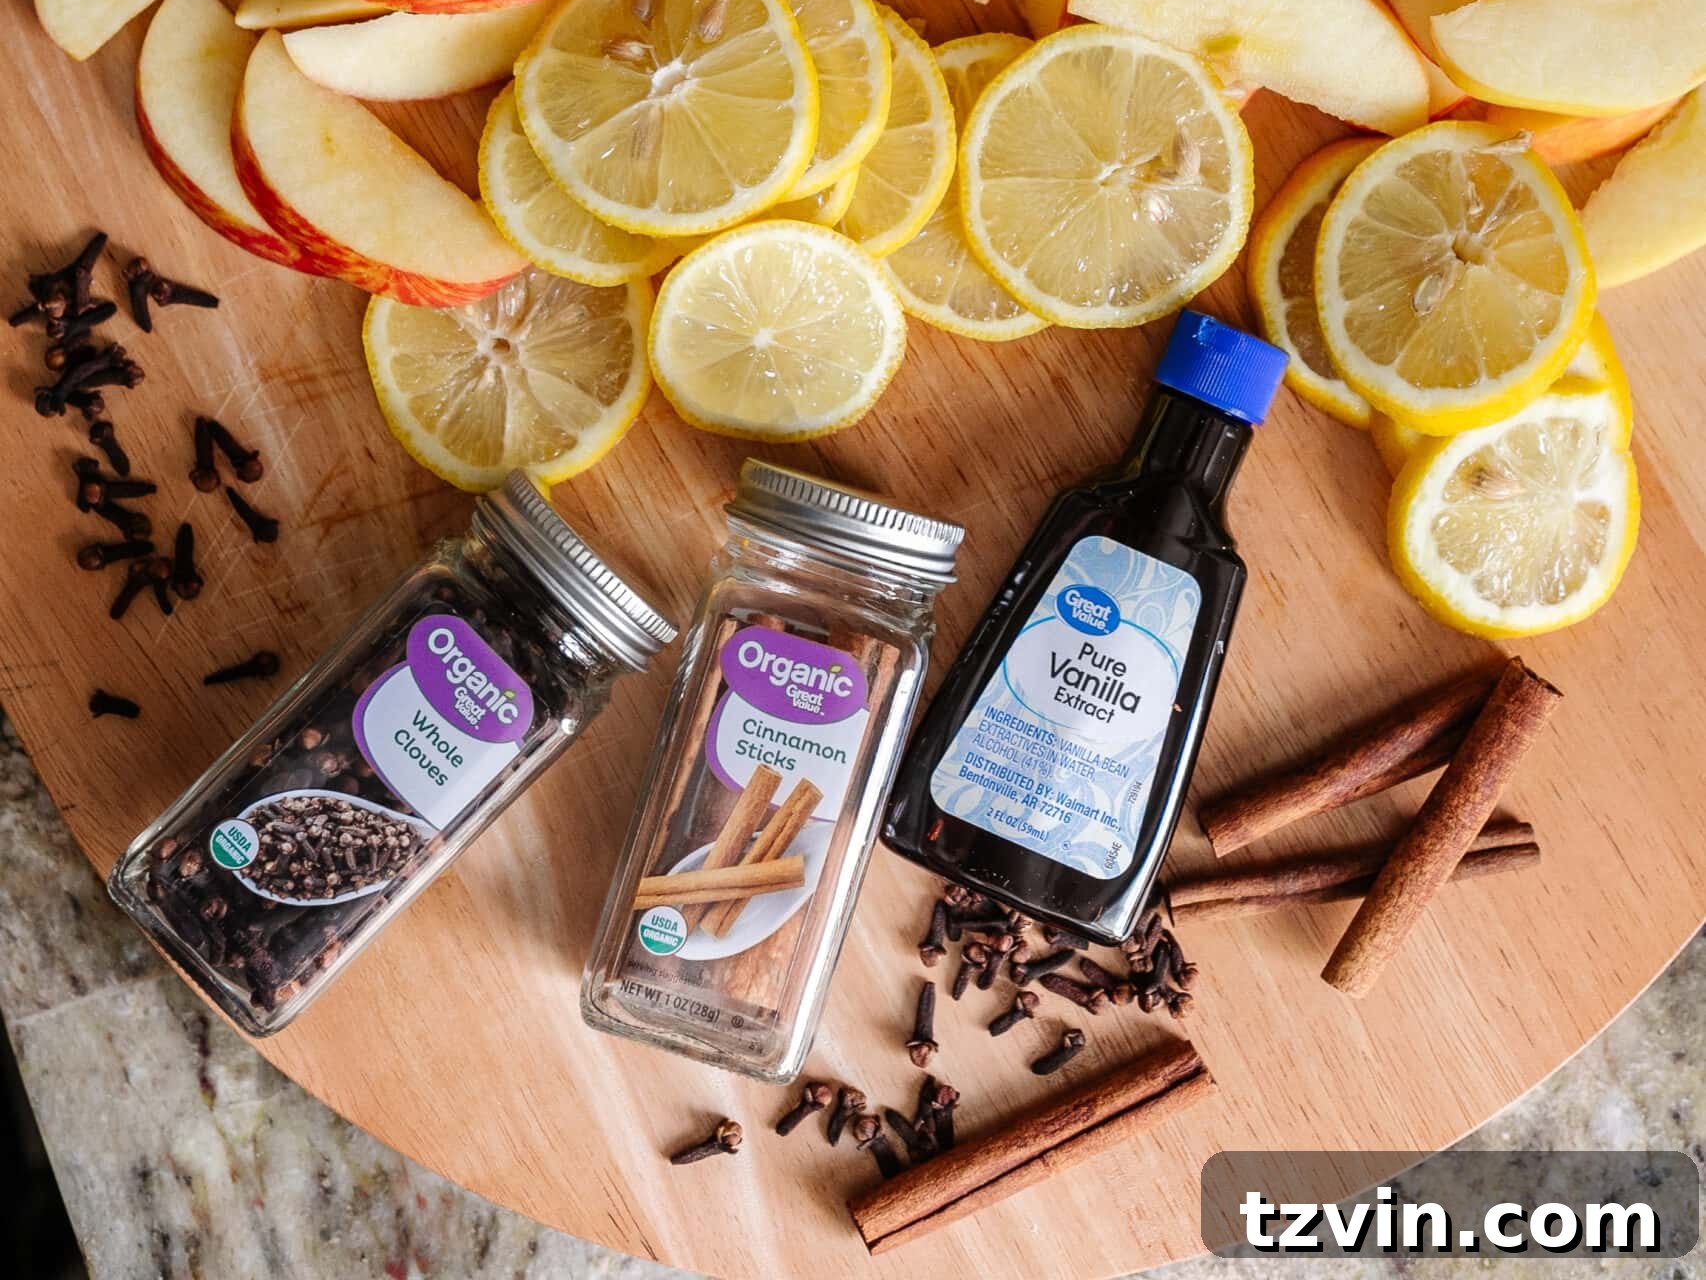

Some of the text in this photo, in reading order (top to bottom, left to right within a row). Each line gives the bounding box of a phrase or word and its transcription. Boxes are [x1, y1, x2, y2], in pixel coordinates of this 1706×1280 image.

[1065, 589, 1112, 620] Great
[1072, 607, 1106, 630] Value
[428, 628, 518, 724] Organic
[738, 640, 853, 697] Organic
[1078, 642, 1127, 677] Pure
[786, 684, 824, 706] Great
[1051, 652, 1141, 713] Vanilla
[454, 687, 486, 719] Great
[455, 700, 478, 725] Value
[792, 697, 820, 714] Value
[1054, 686, 1115, 723] Extract
[412, 710, 464, 768] Whole
[735, 739, 797, 771] Sticks
[743, 719, 846, 764] Cinnamon
[972, 734, 1018, 763] ALCOHOL
[978, 720, 1096, 781] EXTRACTIVES IN WATER,
[984, 706, 1130, 778] INGREDIENTS: VANILLA BEAN
[394, 729, 449, 786] Cloves
[958, 765, 1073, 824] Bentonville, AR 72716
[965, 752, 1122, 832] DISTRIBUTED BY: Walmart Inc.,
[228, 826, 252, 852] USDA
[986, 808, 1049, 842] 2 FL OZ (59mL)
[651, 915, 677, 932] USDA
[620, 980, 720, 1023] NET WT 1 OZ (28g)
